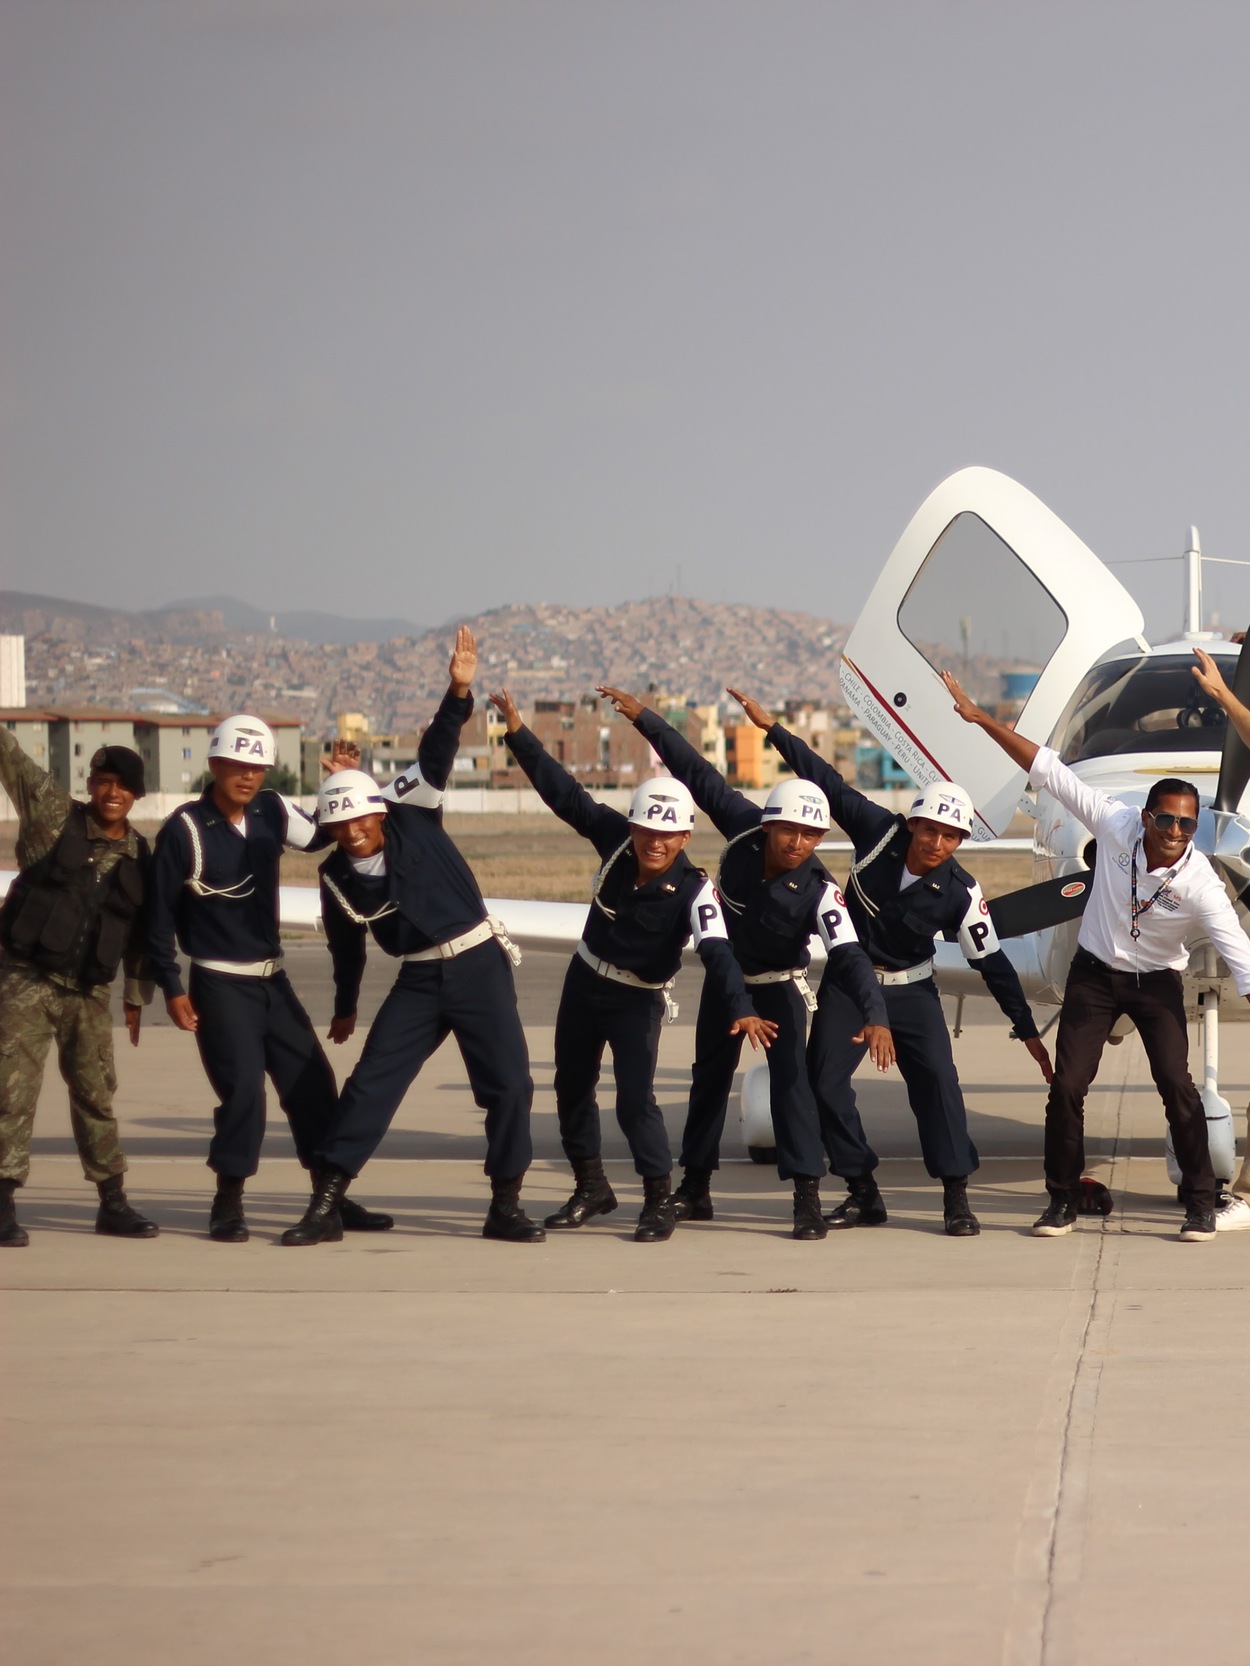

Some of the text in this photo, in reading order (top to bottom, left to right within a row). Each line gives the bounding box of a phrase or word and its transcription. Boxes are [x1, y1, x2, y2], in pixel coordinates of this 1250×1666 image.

[840, 678, 930, 786] PANAMA PARAGUAY PERU UNITE
[844, 672, 861, 692] CHILE
[863, 695, 891, 729] COLOMBIA
[894, 731, 912, 753] COSTA
[912, 751, 925, 770] RICA
[234, 737, 264, 757] PA
[394, 775, 420, 799] P
[328, 796, 354, 814] PA
[647, 804, 677, 824] PA
[801, 804, 823, 822] PA
[937, 803, 961, 822] PA
[698, 904, 718, 932] P
[822, 909, 842, 940] P
[968, 921, 989, 952] P
